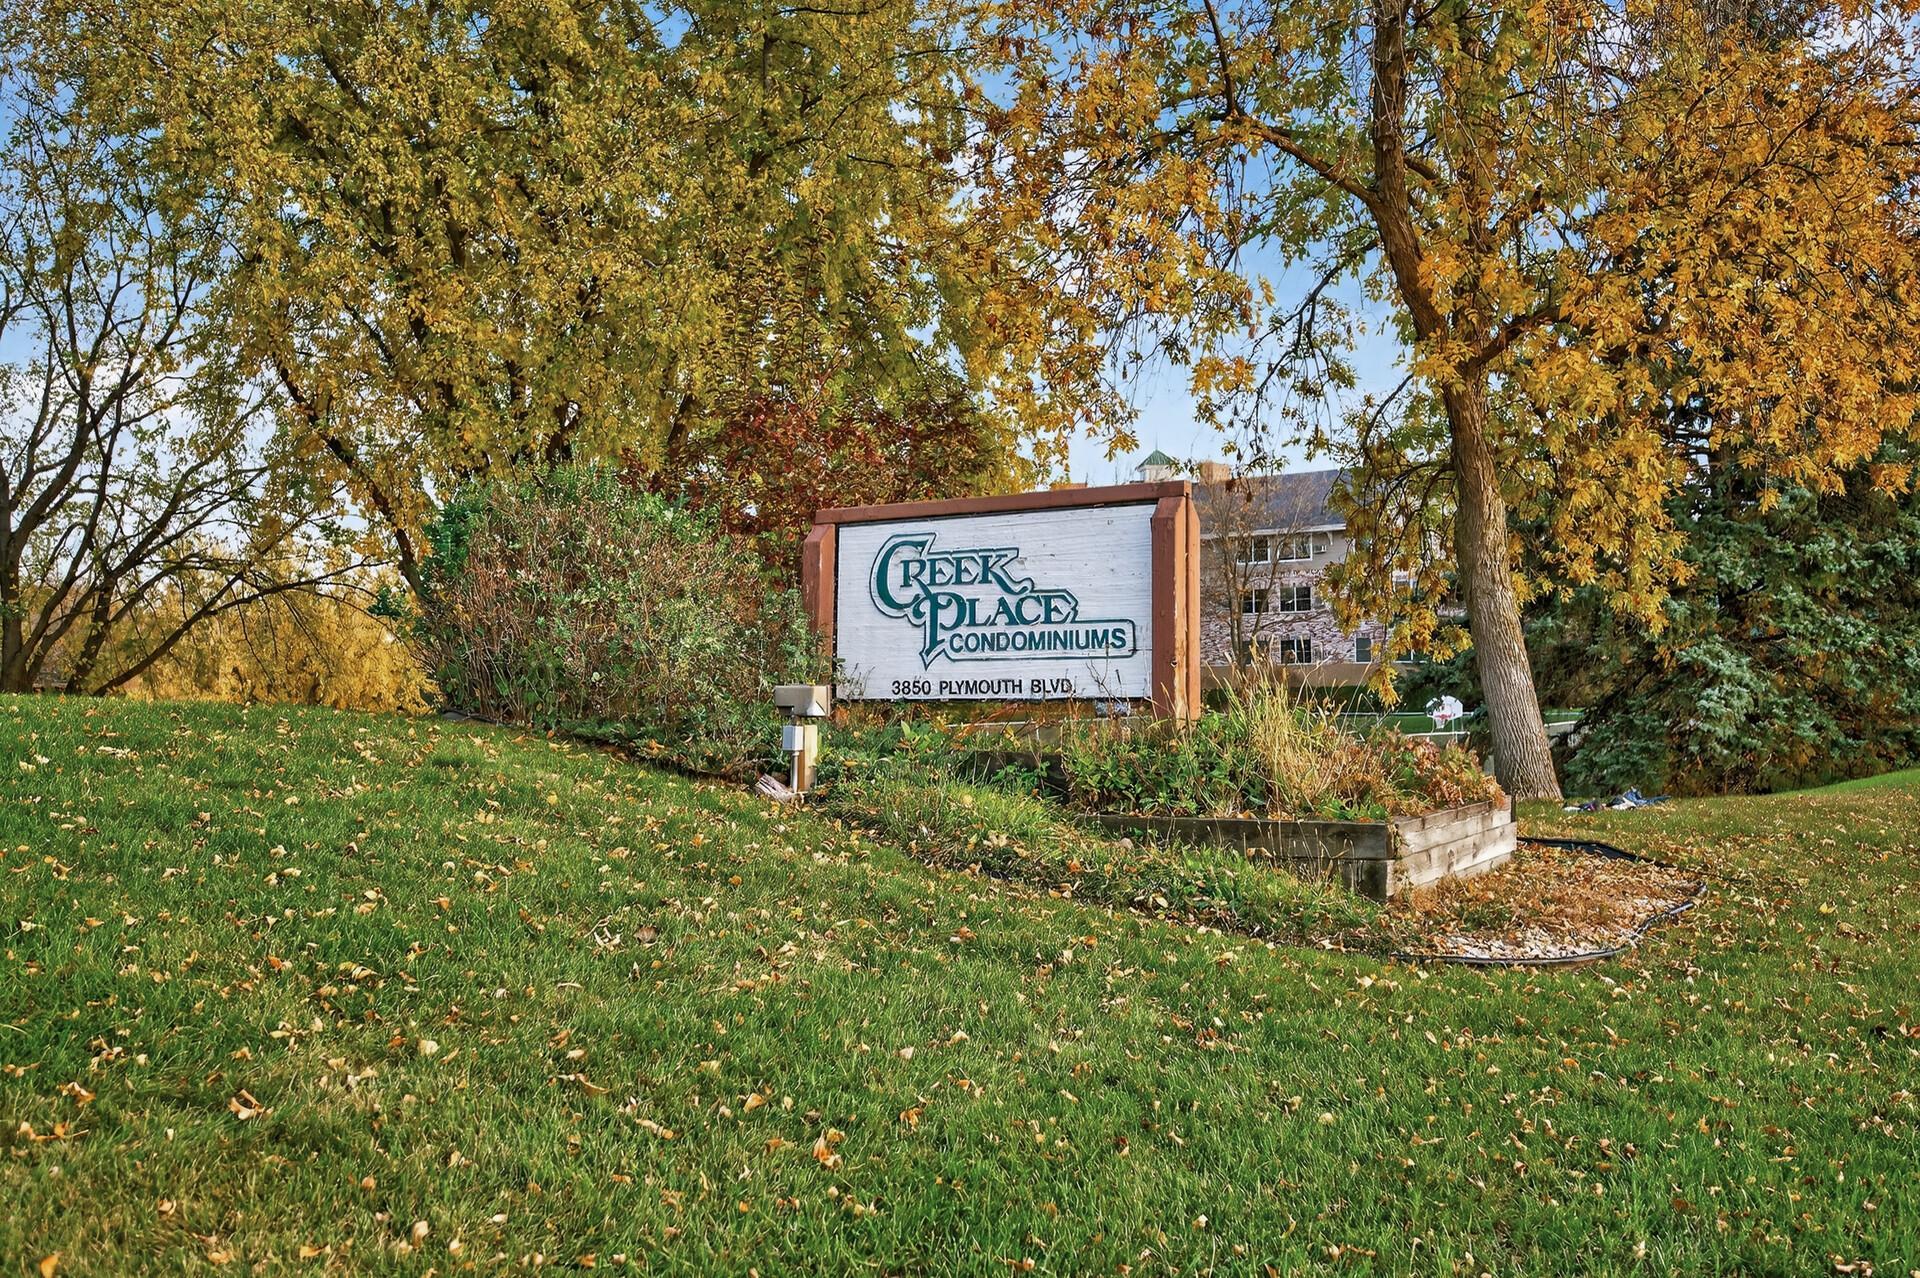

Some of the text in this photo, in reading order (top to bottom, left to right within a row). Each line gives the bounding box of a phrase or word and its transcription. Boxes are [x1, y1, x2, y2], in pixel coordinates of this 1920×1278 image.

[876, 539, 1030, 611] CREEK
[913, 592, 1076, 654] PLACE
[949, 627, 1127, 653] CONDOMINIUMS
[891, 680, 931, 695] 3850
[939, 679, 1022, 695] PLYMOUTH
